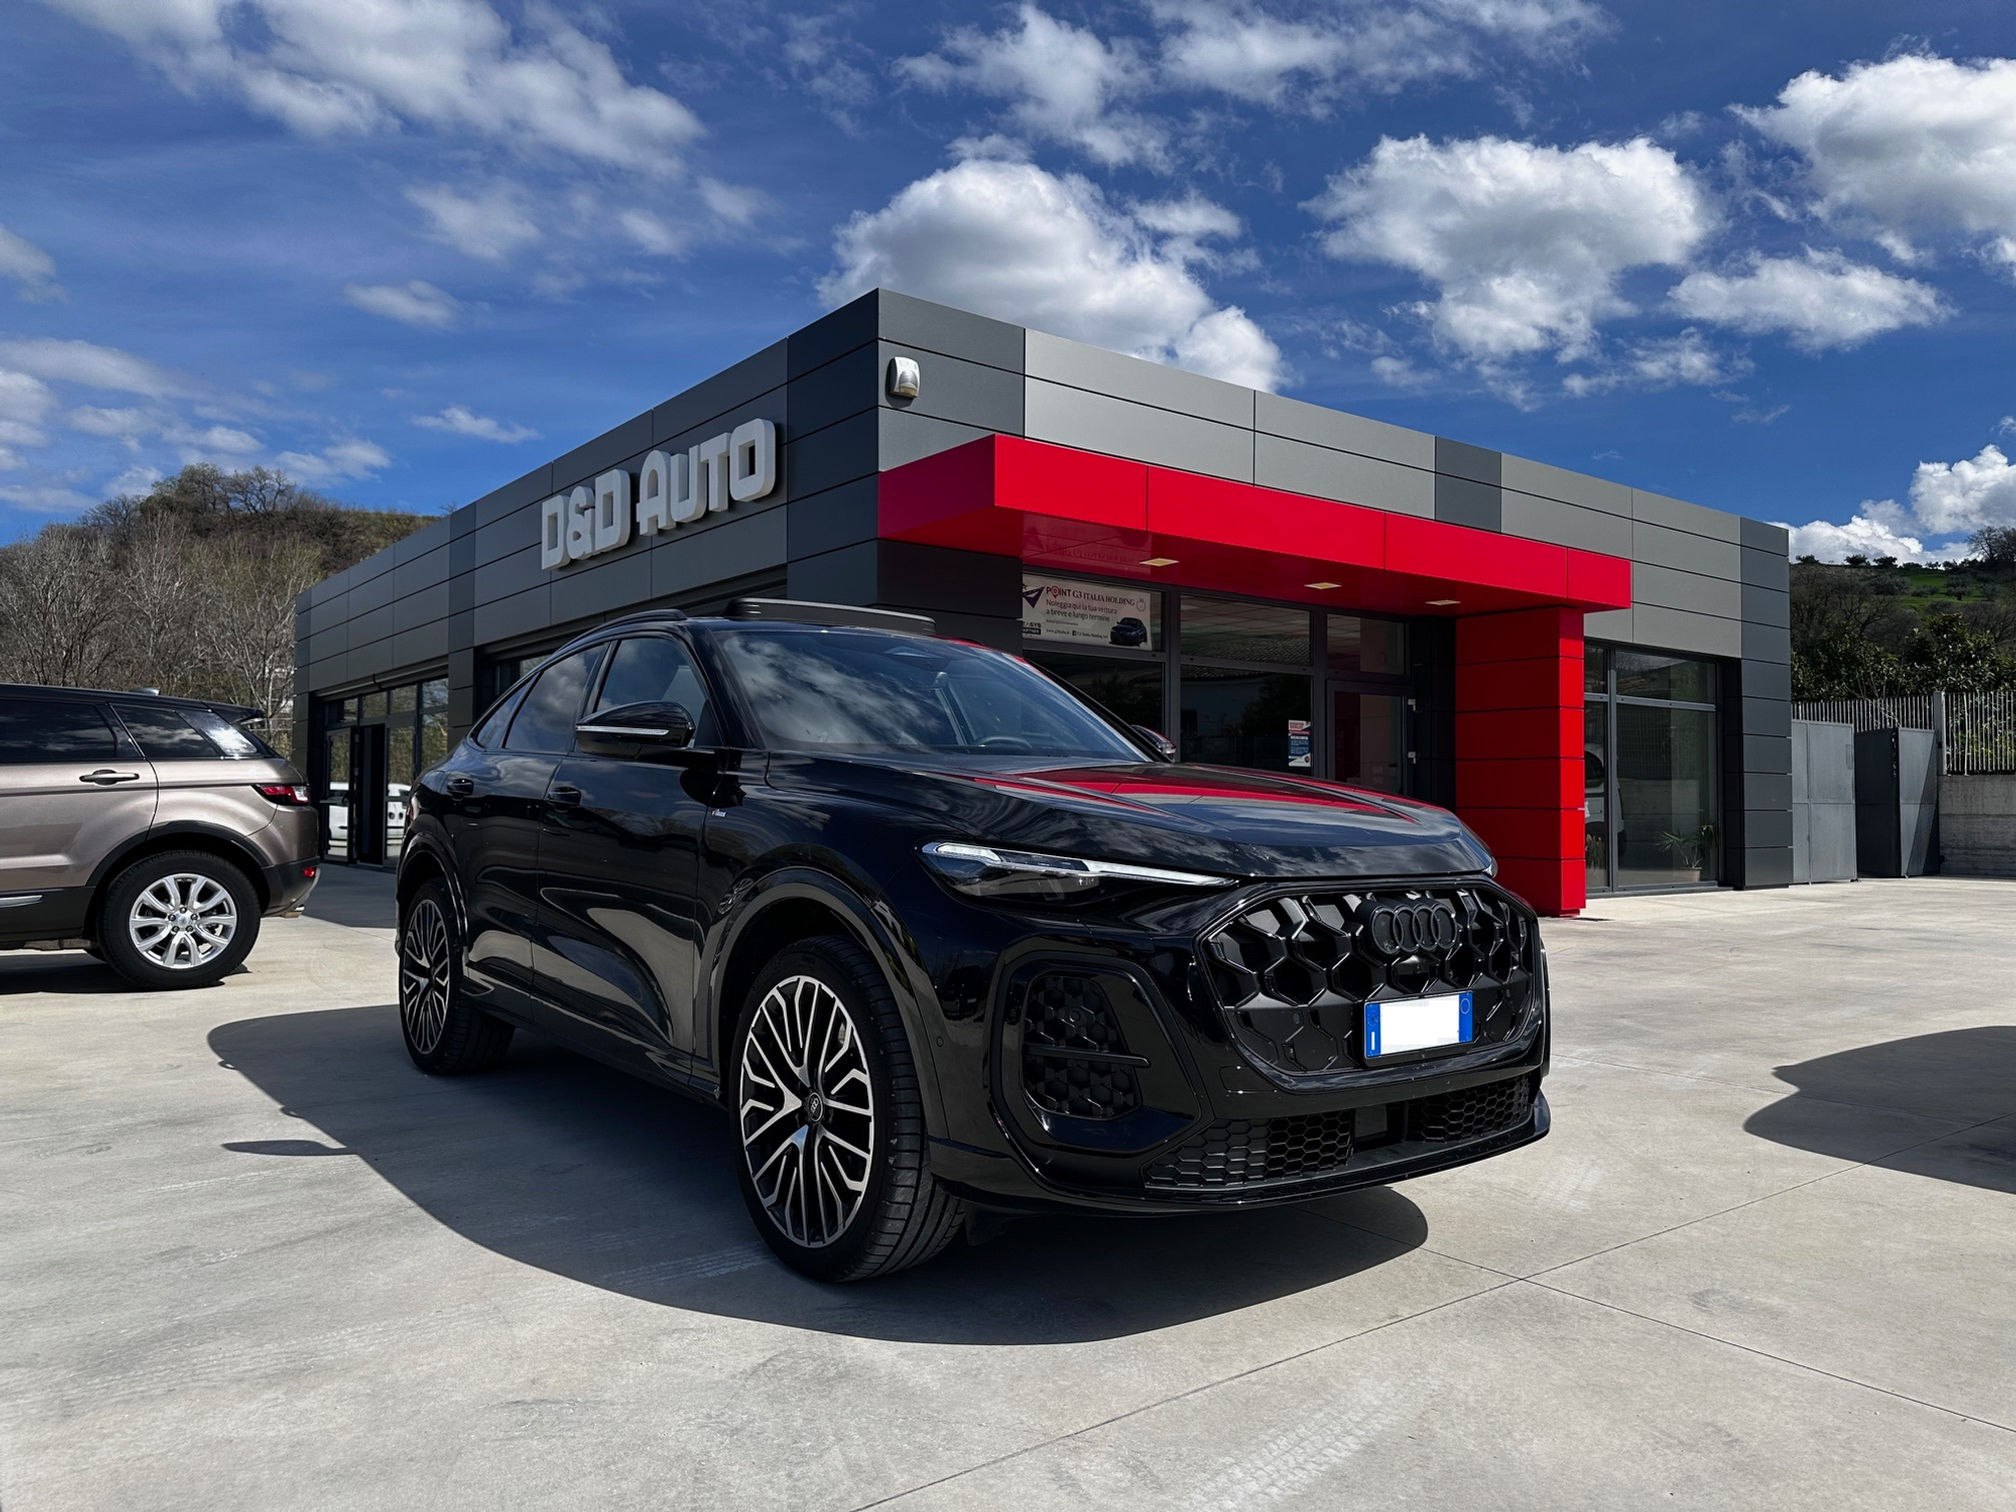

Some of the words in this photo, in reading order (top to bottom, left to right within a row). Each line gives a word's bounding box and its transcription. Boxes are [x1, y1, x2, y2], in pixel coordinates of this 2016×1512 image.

[542, 469, 631, 570] D&D
[1046, 585, 1071, 599] POINT
[1072, 589, 1083, 599] G3
[1083, 592, 1105, 602] ITALIA
[1105, 595, 1135, 606] HOLDING
[1046, 599, 1072, 609] Noleggia
[1088, 604, 1097, 612] tua
[1098, 606, 1118, 614] vettura
[1051, 608, 1068, 617] breve
[1073, 610, 1088, 620] lungo
[1089, 613, 1111, 621] termine
